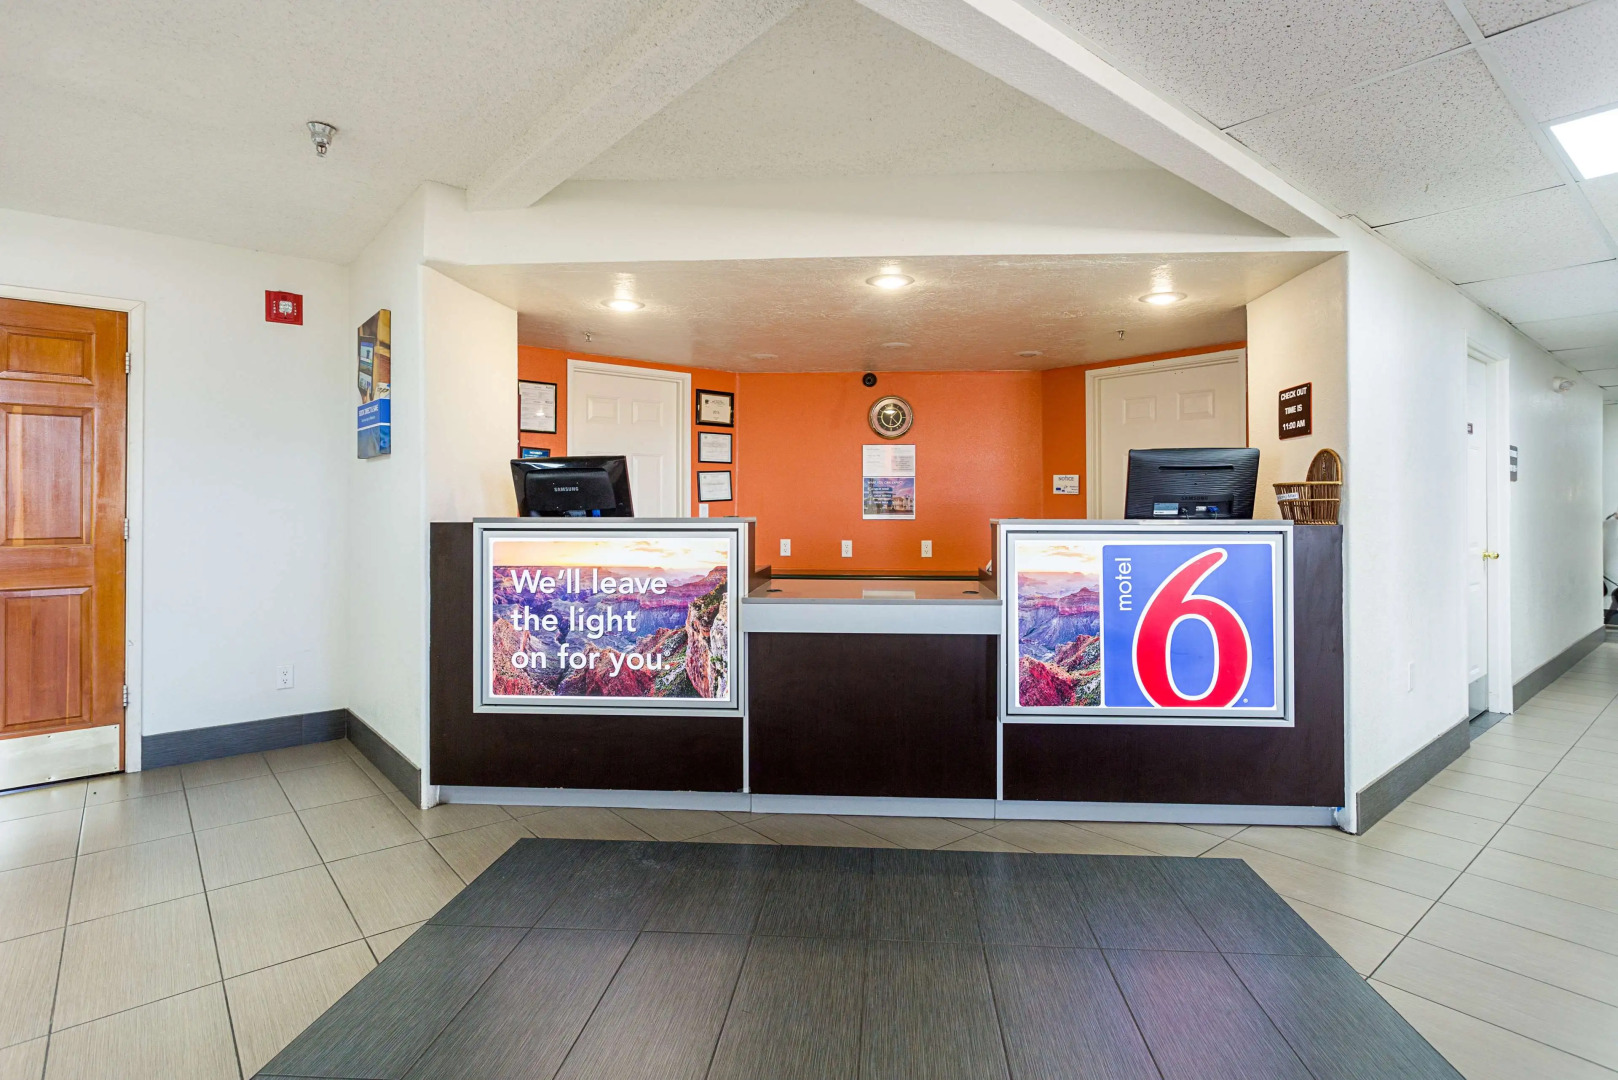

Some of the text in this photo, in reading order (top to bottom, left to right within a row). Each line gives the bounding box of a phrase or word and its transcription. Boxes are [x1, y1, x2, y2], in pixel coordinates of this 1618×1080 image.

[1281, 387, 1307, 401] CHECK OUT
[1285, 403, 1303, 415] TIME IS
[1283, 419, 1305, 430] 11:00 AM
[510, 568, 668, 595] We'll leave
[1114, 557, 1132, 611] motel
[510, 606, 637, 639] the light
[1131, 547, 1253, 708] 6
[511, 653, 546, 669] on
[557, 643, 599, 670] for
